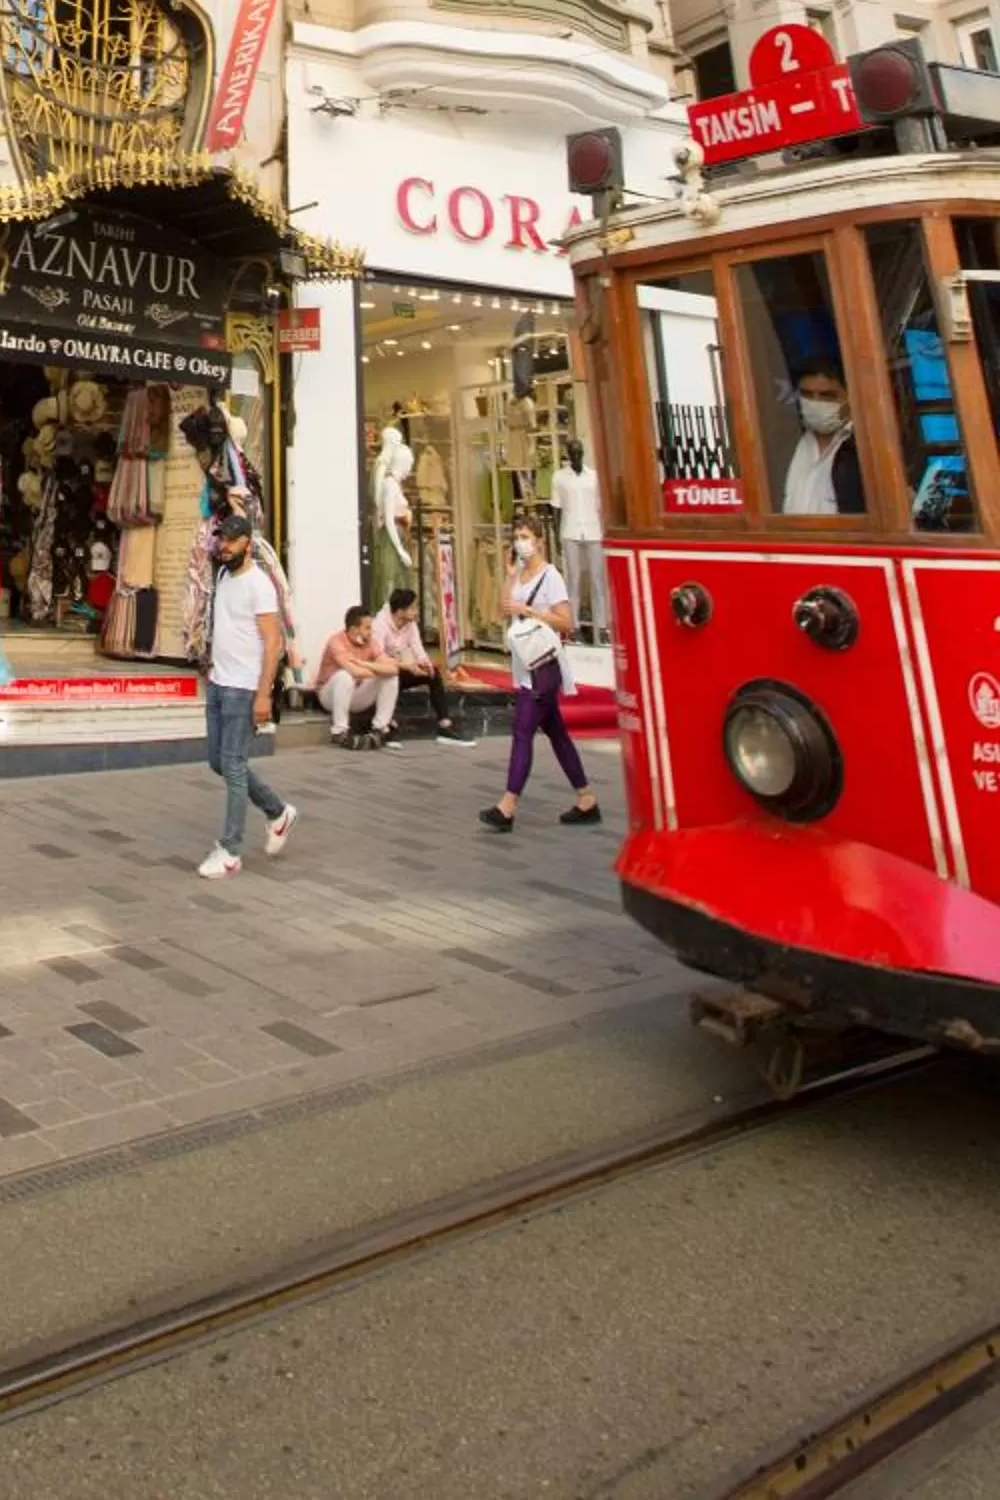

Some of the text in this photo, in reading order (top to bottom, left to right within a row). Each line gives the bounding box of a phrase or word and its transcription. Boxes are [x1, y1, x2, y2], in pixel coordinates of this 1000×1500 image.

[774, 31, 800, 73] 2
[695, 96, 782, 148] TAKSİM
[831, 75, 856, 112] T
[12, 229, 200, 299] AZNAVUR
[63, 339, 131, 366] OMAYRA
[133, 349, 172, 370] CAFE
[188, 357, 229, 382] Okey
[673, 485, 743, 506] TÜNEL
